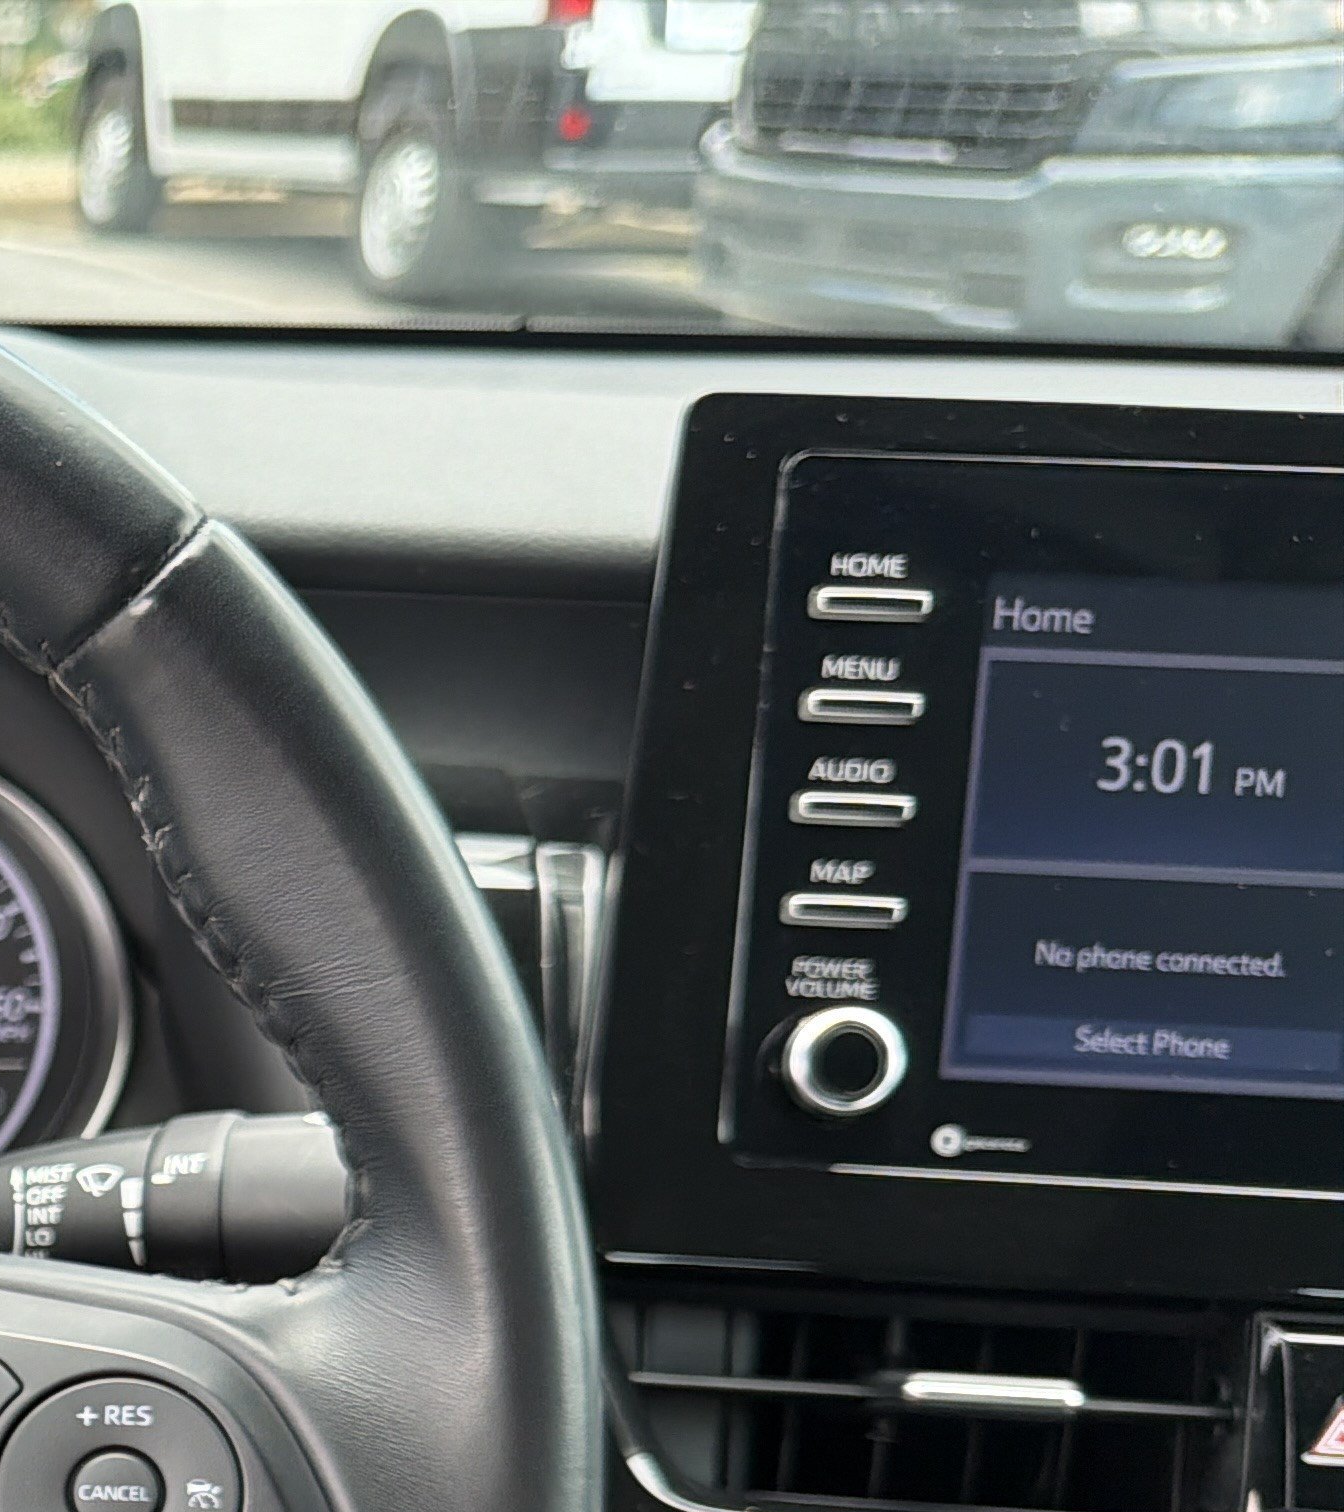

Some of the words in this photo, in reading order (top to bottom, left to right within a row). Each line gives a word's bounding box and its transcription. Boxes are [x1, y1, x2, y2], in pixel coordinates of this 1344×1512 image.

[829, 552, 908, 580] HOME
[992, 597, 1095, 636] Home
[820, 655, 900, 682] MENU
[807, 758, 895, 785] AUDIO
[1095, 736, 1215, 795] 3:01
[1234, 766, 1287, 798] PM
[809, 858, 876, 886] MAP
[792, 956, 873, 979] POWER
[1034, 939, 1074, 968] No
[1076, 942, 1154, 973] phone
[1155, 952, 1287, 978] connected.
[785, 977, 880, 1001] VOLUME
[1073, 1024, 1149, 1056] Select
[1152, 1029, 1232, 1061] Phone
[26, 1163, 76, 1186] MIST
[163, 1152, 208, 1174] INT
[26, 1184, 69, 1206] OFF
[27, 1204, 65, 1225] INT
[25, 1227, 57, 1247] LO
[77, 1484, 151, 1503] CANCEL
